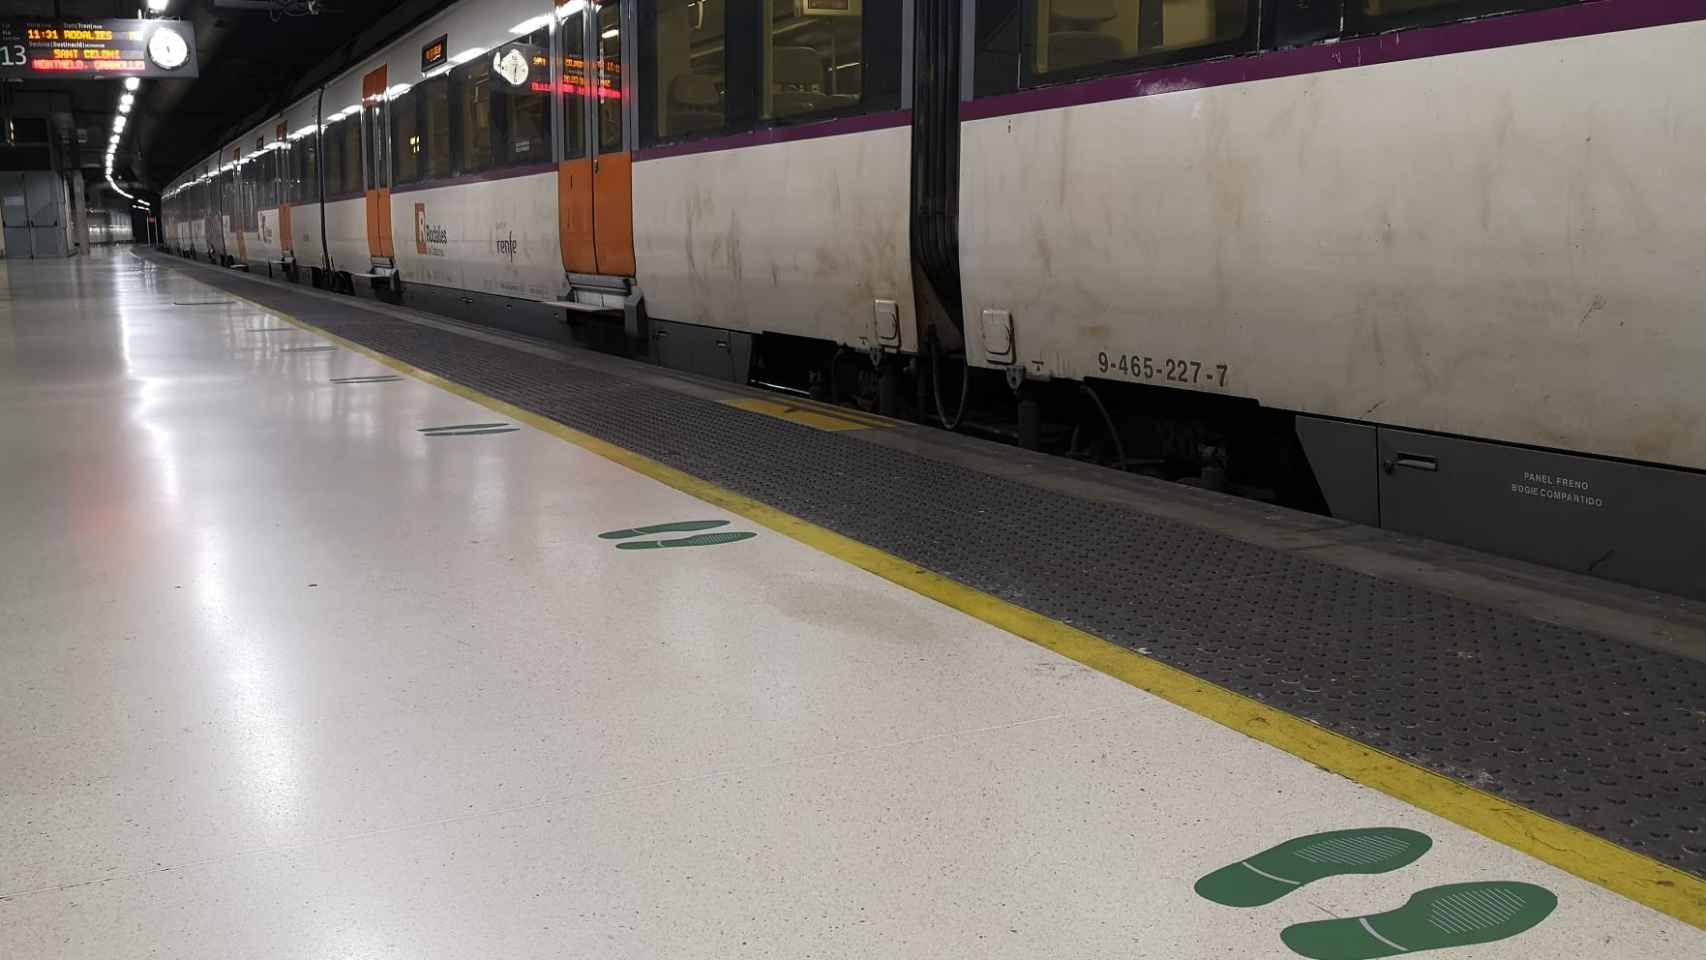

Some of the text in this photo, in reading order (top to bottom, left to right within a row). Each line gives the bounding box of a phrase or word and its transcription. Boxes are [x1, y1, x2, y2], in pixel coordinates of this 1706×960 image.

[63, 30, 113, 40] RODALIES
[0, 44, 27, 66] 13
[53, 48, 79, 59] SANT
[495, 231, 518, 263] renfe
[1098, 351, 1228, 388] 9-465-227-7
[1523, 471, 1589, 491] PANEL FRENO
[1511, 483, 1603, 507] BOGIE COMPARTIDO
